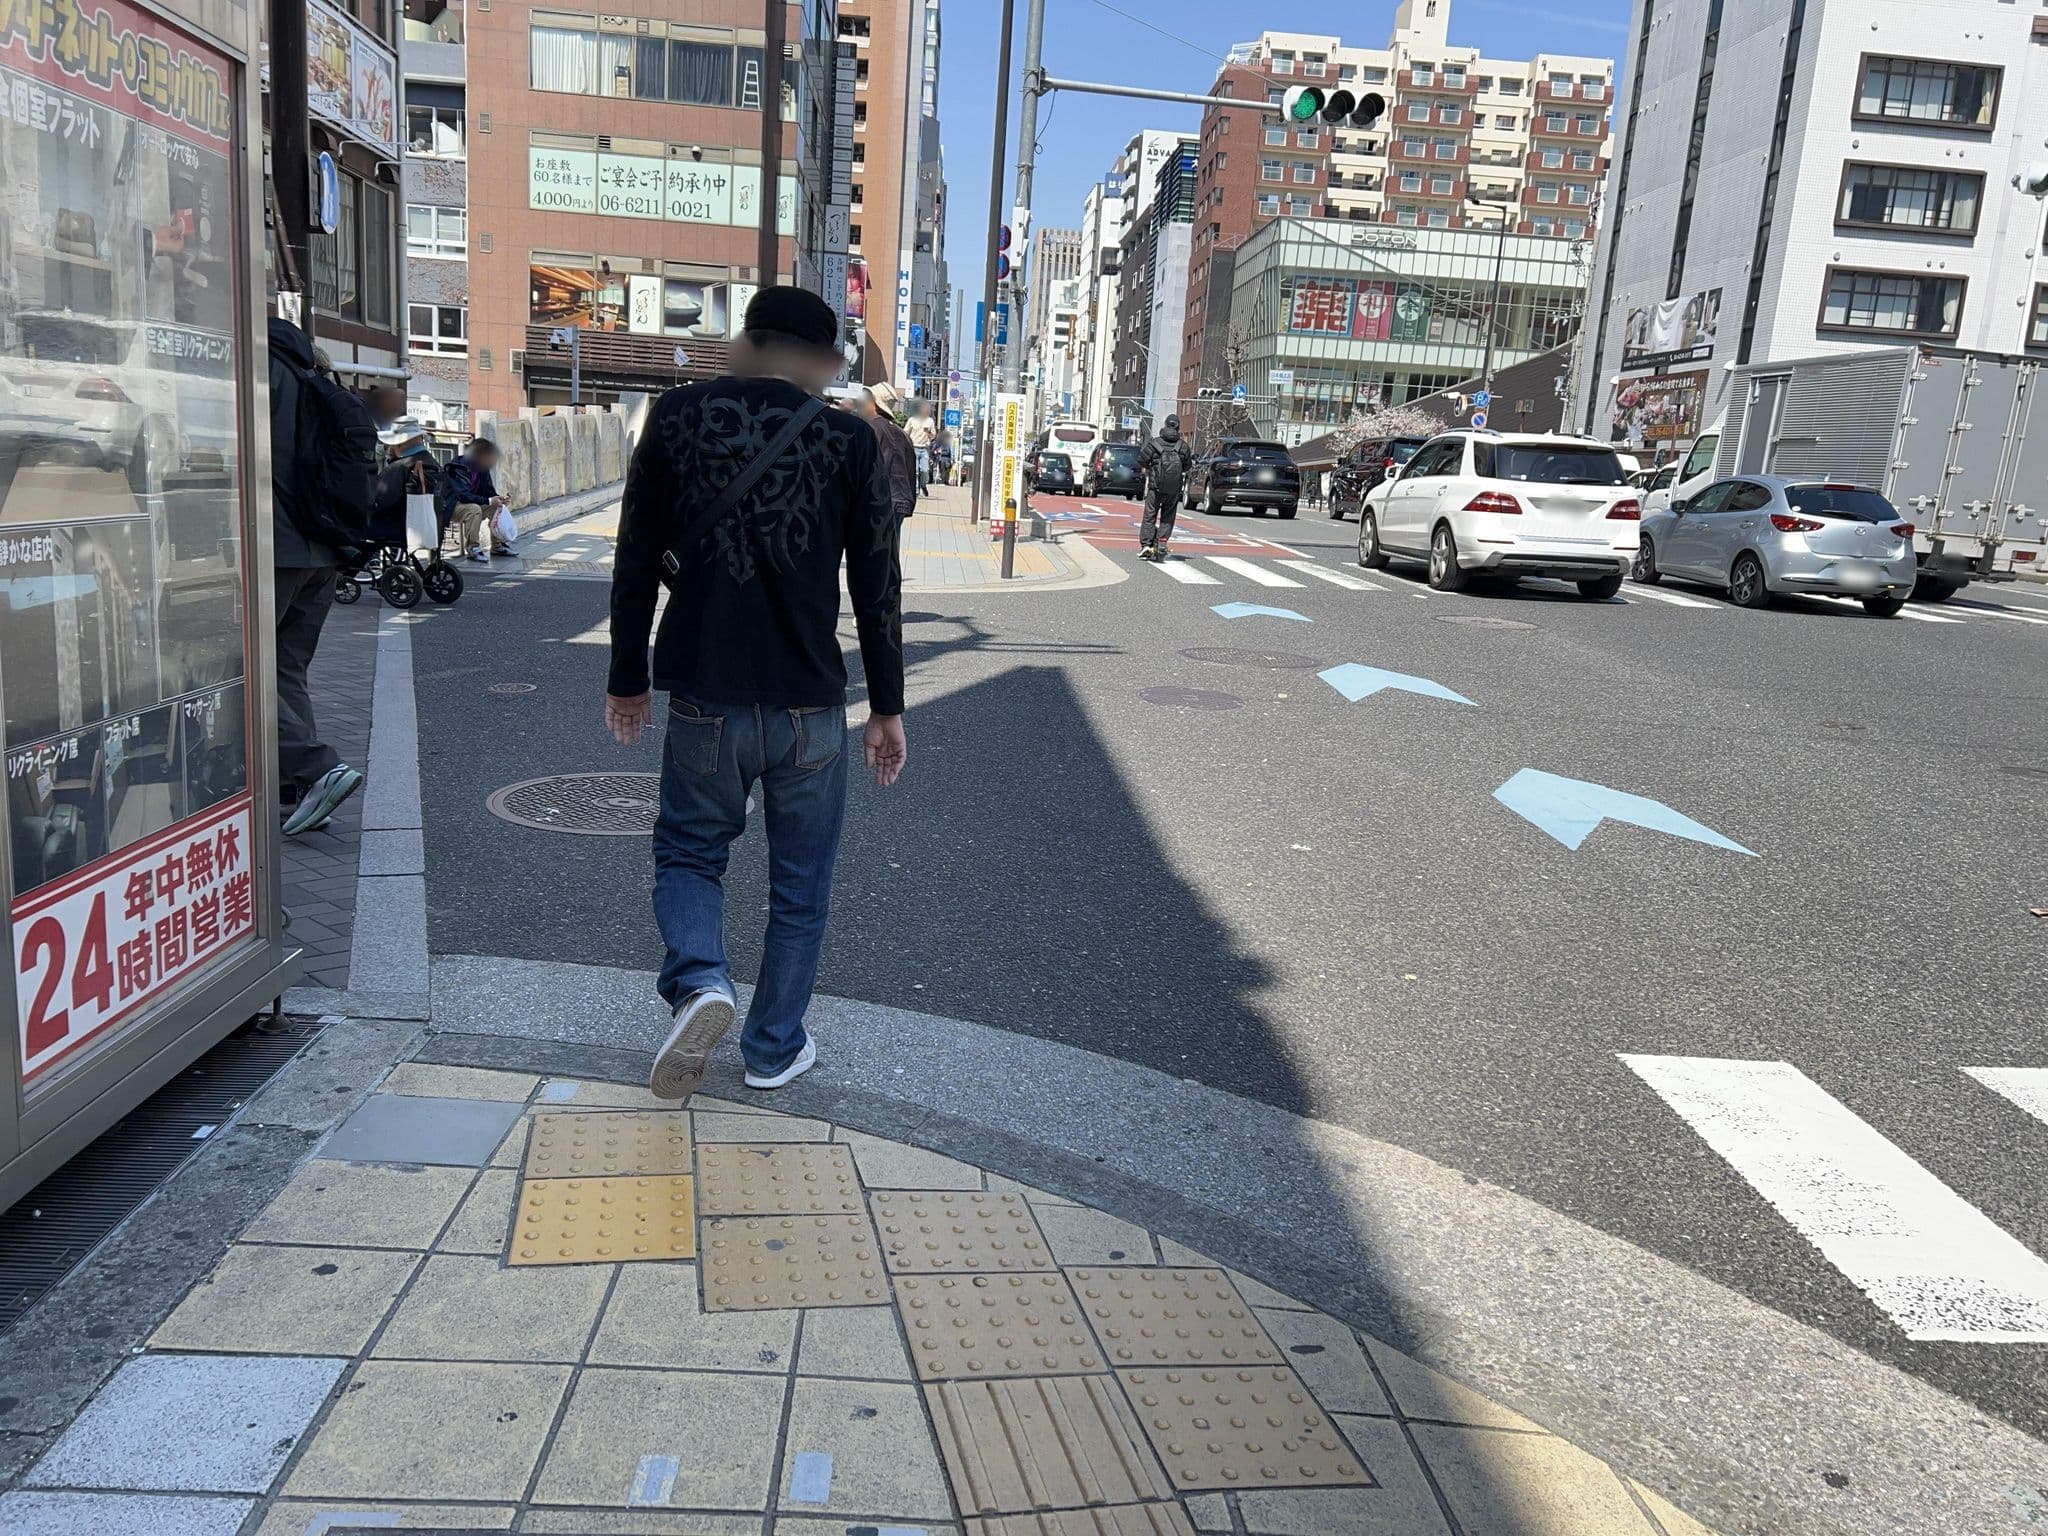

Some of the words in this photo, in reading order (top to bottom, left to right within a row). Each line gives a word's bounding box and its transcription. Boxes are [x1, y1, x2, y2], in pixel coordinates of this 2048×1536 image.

[533, 170, 593, 187] 60名様まで
[535, 157, 571, 172] お座敷
[600, 166, 727, 197] ご宴会ご予約承り中
[600, 194, 713, 220] 06-6211-0021
[1352, 232, 1417, 246] DOTON
[897, 270, 909, 347] HOTEL
[147, 328, 232, 363] 完全個室リクライニング
[105, 716, 141, 745] フラット席
[8, 737, 79, 779] リクライニング席
[123, 823, 241, 922] 年中無休
